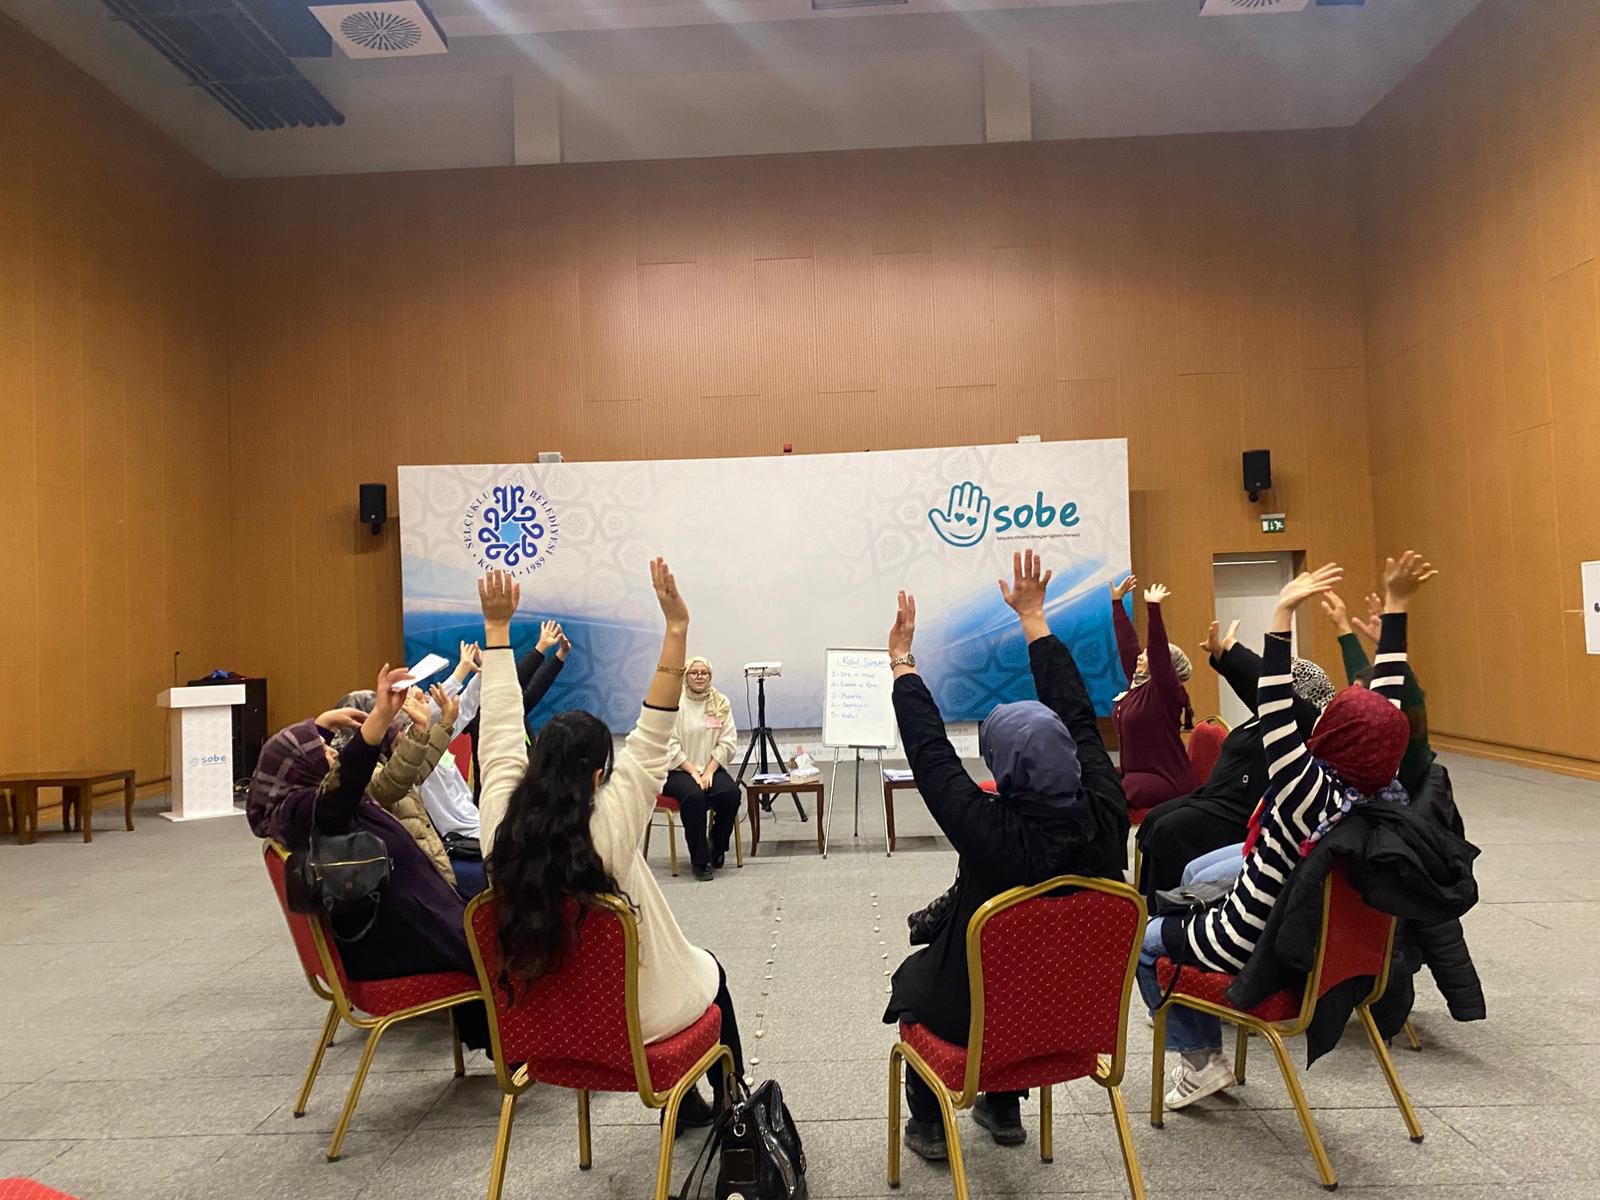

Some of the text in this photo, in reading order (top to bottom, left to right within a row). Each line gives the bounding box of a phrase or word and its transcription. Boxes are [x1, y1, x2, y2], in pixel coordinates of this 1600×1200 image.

[464, 490, 490, 550] SELÇUKLU
[993, 491, 1080, 533] sobe
[525, 556, 545, 575] 1989
[201, 754, 225, 763] sobe
